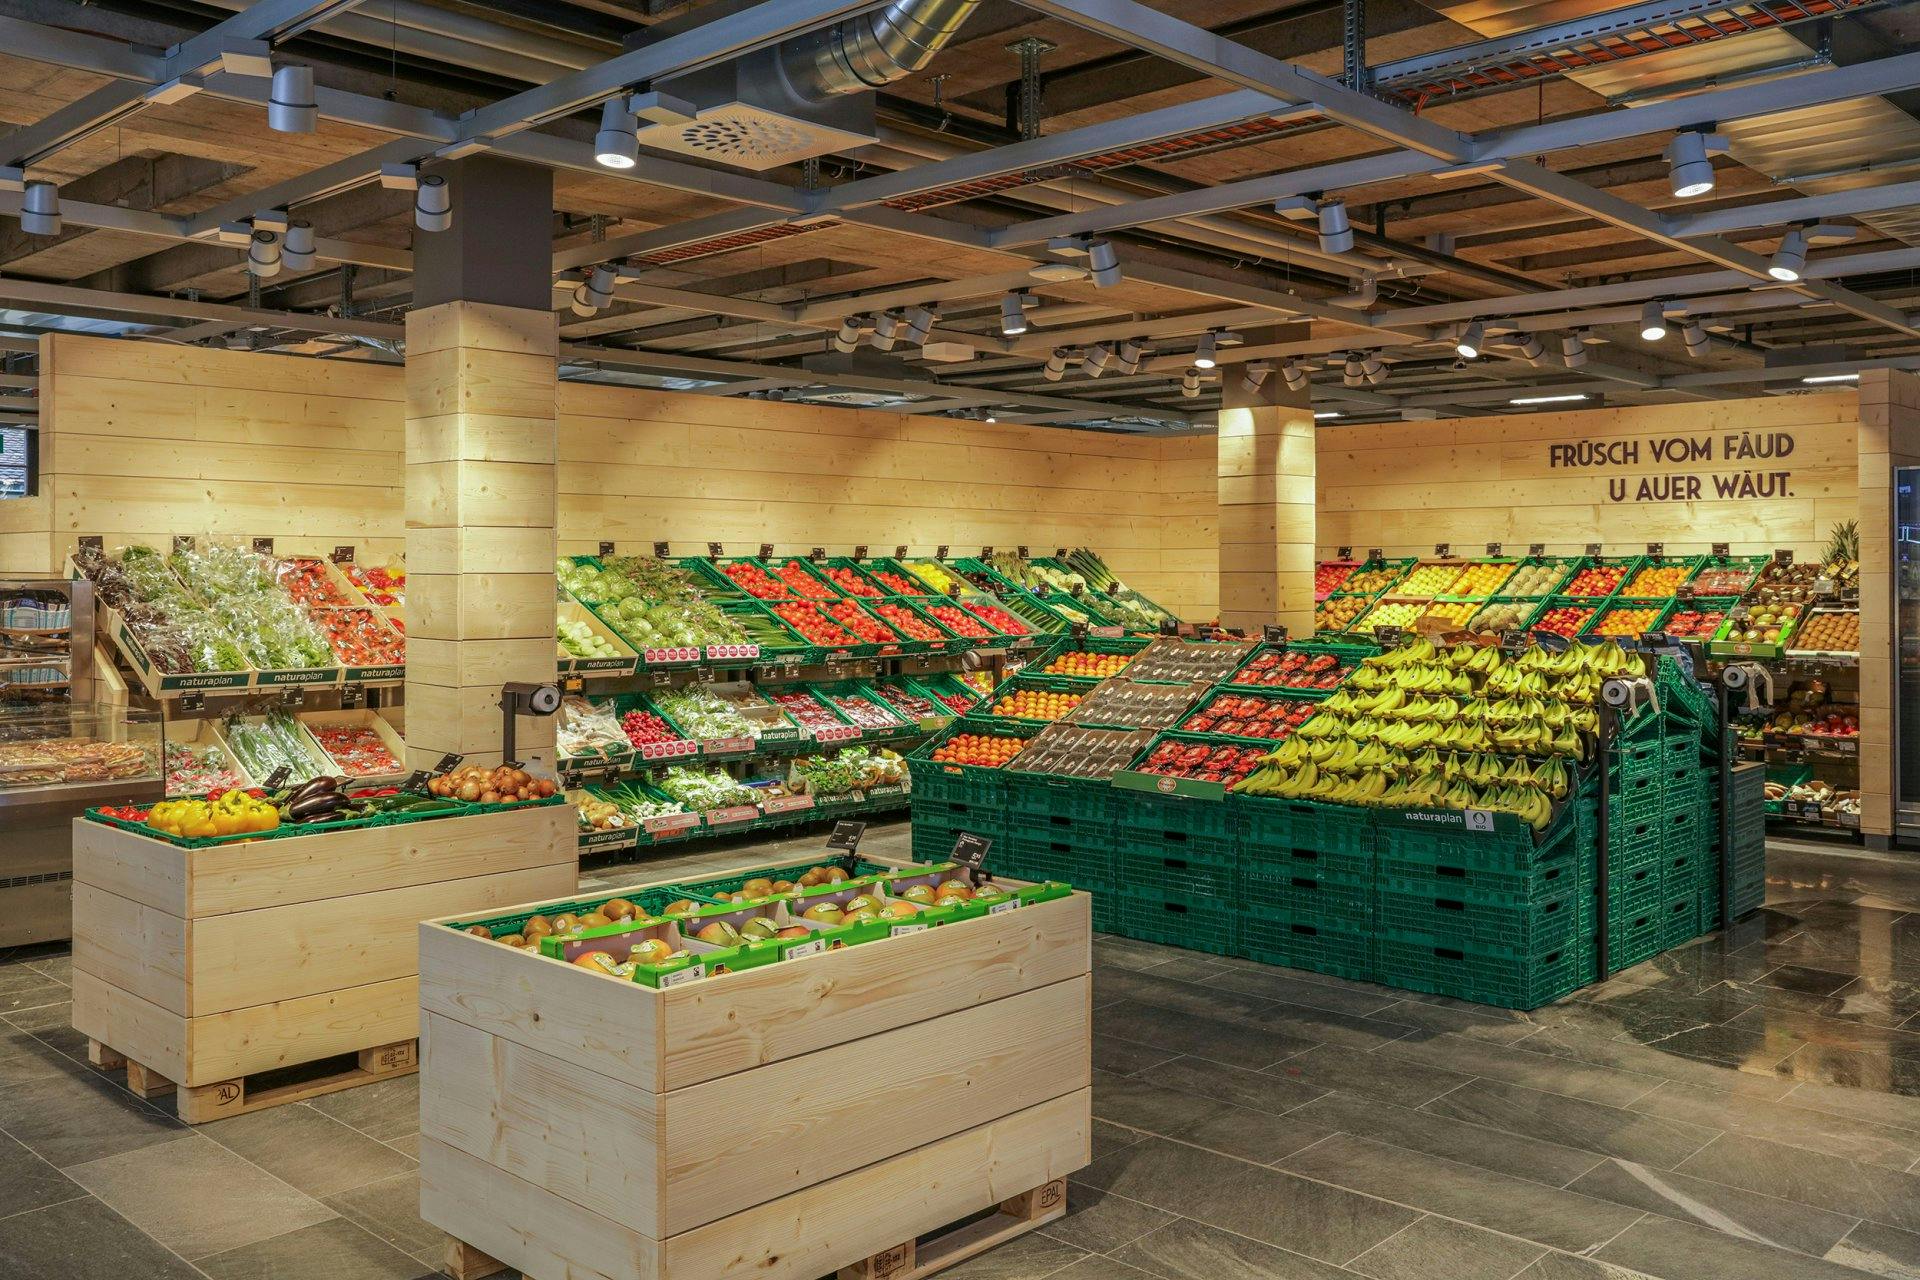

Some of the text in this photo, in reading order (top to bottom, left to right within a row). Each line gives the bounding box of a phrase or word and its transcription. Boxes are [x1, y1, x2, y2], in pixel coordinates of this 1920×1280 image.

[1550, 431, 1794, 468] FRÜSCH VOM FÄUD
[1609, 470, 1795, 502] U AUER WÄUT.
[587, 659, 624, 668] naturaplan
[179, 675, 233, 687] naturaplan
[274, 672, 323, 682] naturaplan
[763, 730, 798, 744] naturaplan
[1405, 812, 1463, 824] naturaplan
[588, 831, 626, 843] naturaplan
[1042, 1186, 1060, 1206] EPAL
